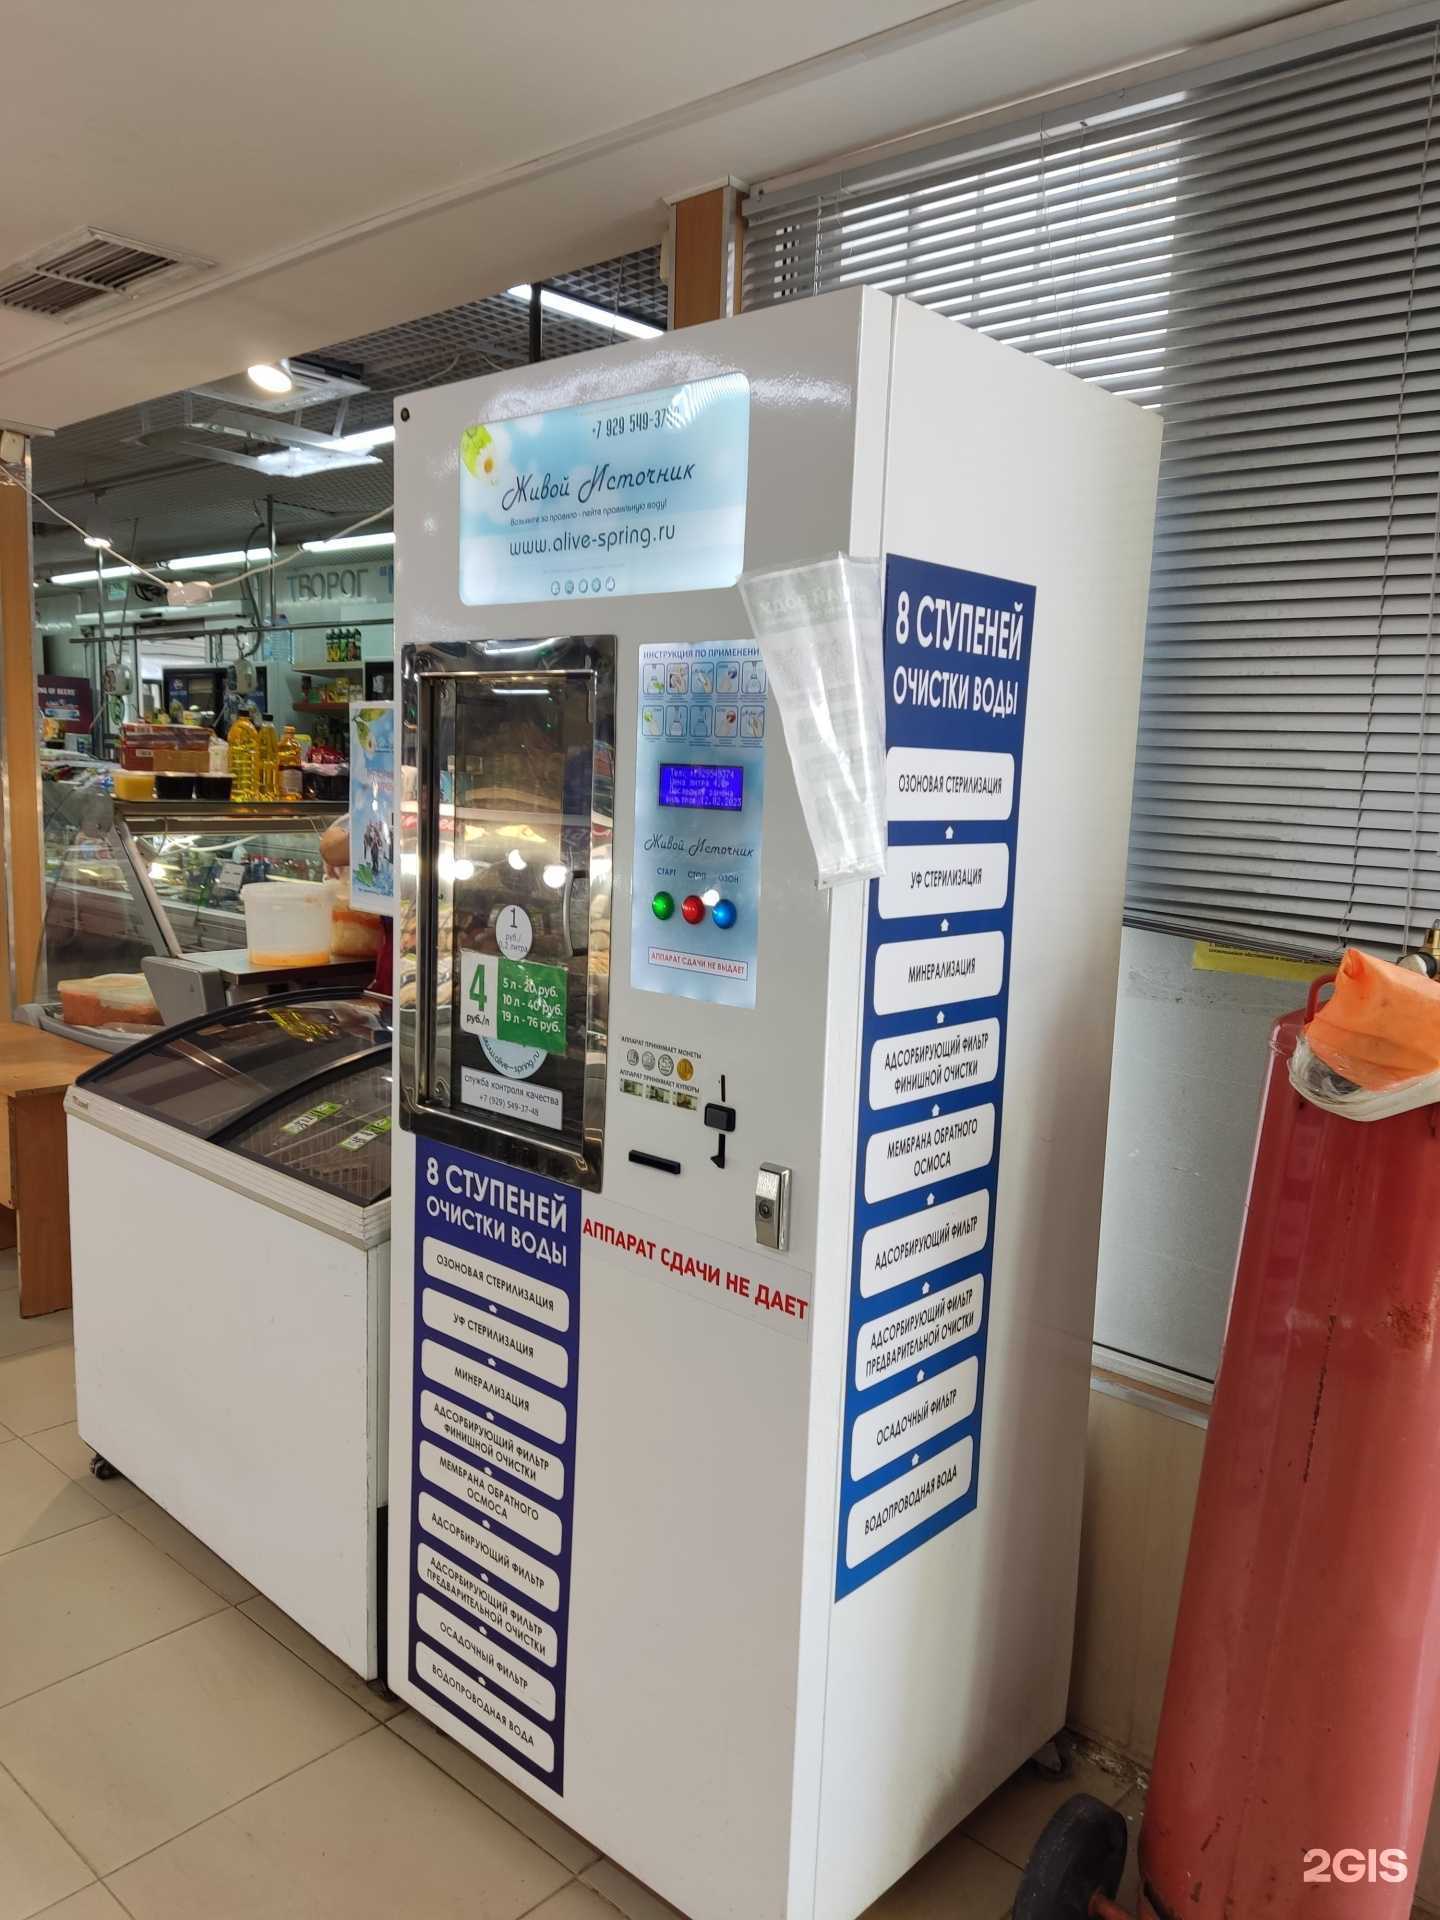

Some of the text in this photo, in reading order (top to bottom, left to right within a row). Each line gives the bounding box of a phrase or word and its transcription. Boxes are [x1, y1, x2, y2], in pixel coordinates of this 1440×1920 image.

[606, 416, 625, 437] 929
[501, 463, 696, 511] Живой Источник
[510, 524, 676, 556] www.alive-spring.ru
[287, 568, 369, 602] ТВОРОГ
[895, 590, 910, 645] 8
[916, 595, 1024, 661] СТУПЕНЕЙ
[643, 647, 760, 660] ИНСТРУКЦИЯ ПО ПРИМЕНЕНИ
[893, 666, 1019, 719] ОЧИСТКИ ВОДЫ
[898, 774, 1002, 795] ОЗОНОВАЯ СТЕРИЛИЗАЦИЯ
[644, 832, 754, 857] Живой Источник
[657, 867, 676, 877] СТАРТ
[911, 868, 983, 889] УФ СТЕРИЛИЗАЦИЯ
[510, 907, 518, 928] 1
[651, 951, 745, 975] АППАРАТ СДАЧИ НЕ ВЫДАЕТ
[908, 957, 976, 983] МИНЕРАЛИЗАЦИЯ
[469, 964, 487, 1011] 4
[503, 977, 509, 988] 5
[538, 985, 558, 998] руб.
[503, 993, 512, 1006] 10
[528, 1000, 540, 1011] 40
[542, 1003, 563, 1018] руб.
[466, 1013, 490, 1026] руб./л
[502, 1010, 511, 1022] 19
[527, 1015, 539, 1028] 76
[540, 1020, 560, 1033] руб.
[884, 1032, 989, 1071] АДСОРБИРУЮЩИЙ ФИЛЬТР
[491, 1081, 524, 1096] контроля
[526, 1091, 559, 1106] качества
[894, 1060, 978, 1094] ФИНИШНОЙ ОЧИСТКИ
[887, 1118, 978, 1160] МЕМБРАНА ОБРАТНОГО
[913, 1151, 951, 1177] ОСМОСА
[426, 1156, 567, 1233] 8 СТУПЕНЕЙ
[426, 1195, 567, 1267] ОЧИСТКИ ВОДЫ
[874, 1215, 977, 1270] АДСОРБИРУЮЩИЙ ФИЛЬТР
[436, 1254, 554, 1311] ОЗОНОВАЯ СТЕРИЛИЗАЦИЯ
[583, 1218, 808, 1319] АППАРАТ СДАЧИ НЕ ДАЕТ
[453, 1312, 534, 1358] УФ СТЕРИЛИЗАЦИЯ
[871, 1289, 973, 1351] АДСОРБИРУЮЩИЙ ФИЛЬТР
[865, 1311, 975, 1377] ПРЕДВАРИТЕЛЬНОЙ ОЧИСТКИ
[454, 1367, 530, 1412] МИНЕРАЛИЗАЦИЯ
[434, 1402, 550, 1470] АДСОРБИРУЮЩИЙ ФИЛЬТР
[876, 1389, 957, 1446] ОСАДОЧНЫЙ ФИЛЬТР
[444, 1424, 536, 1481] ФИНИШНОЙ ОЧИСТКИ
[440, 1456, 539, 1521] МЕМБРАНА ОБРАТНОГО
[467, 1487, 508, 1520] ОСМОСА
[864, 1465, 957, 1535] ВОДОПРОВОДНАЯ ВОДА
[431, 1512, 544, 1589] АДСОРБИРУЮЩИЙ ФИЛЬТР
[427, 1568, 546, 1656] ПРЕДВАРИТЕЛЬНОЙ ОЧИСТКИ
[430, 1556, 543, 1636] АДСОРБИРУЮЩИЙ ФИЛЬТР
[440, 1621, 528, 1690] ОСАДОЧНЫЙ ФИЛЬТР
[432, 1663, 534, 1746] ВОДОПРОВОДНАЯ ВОДА
